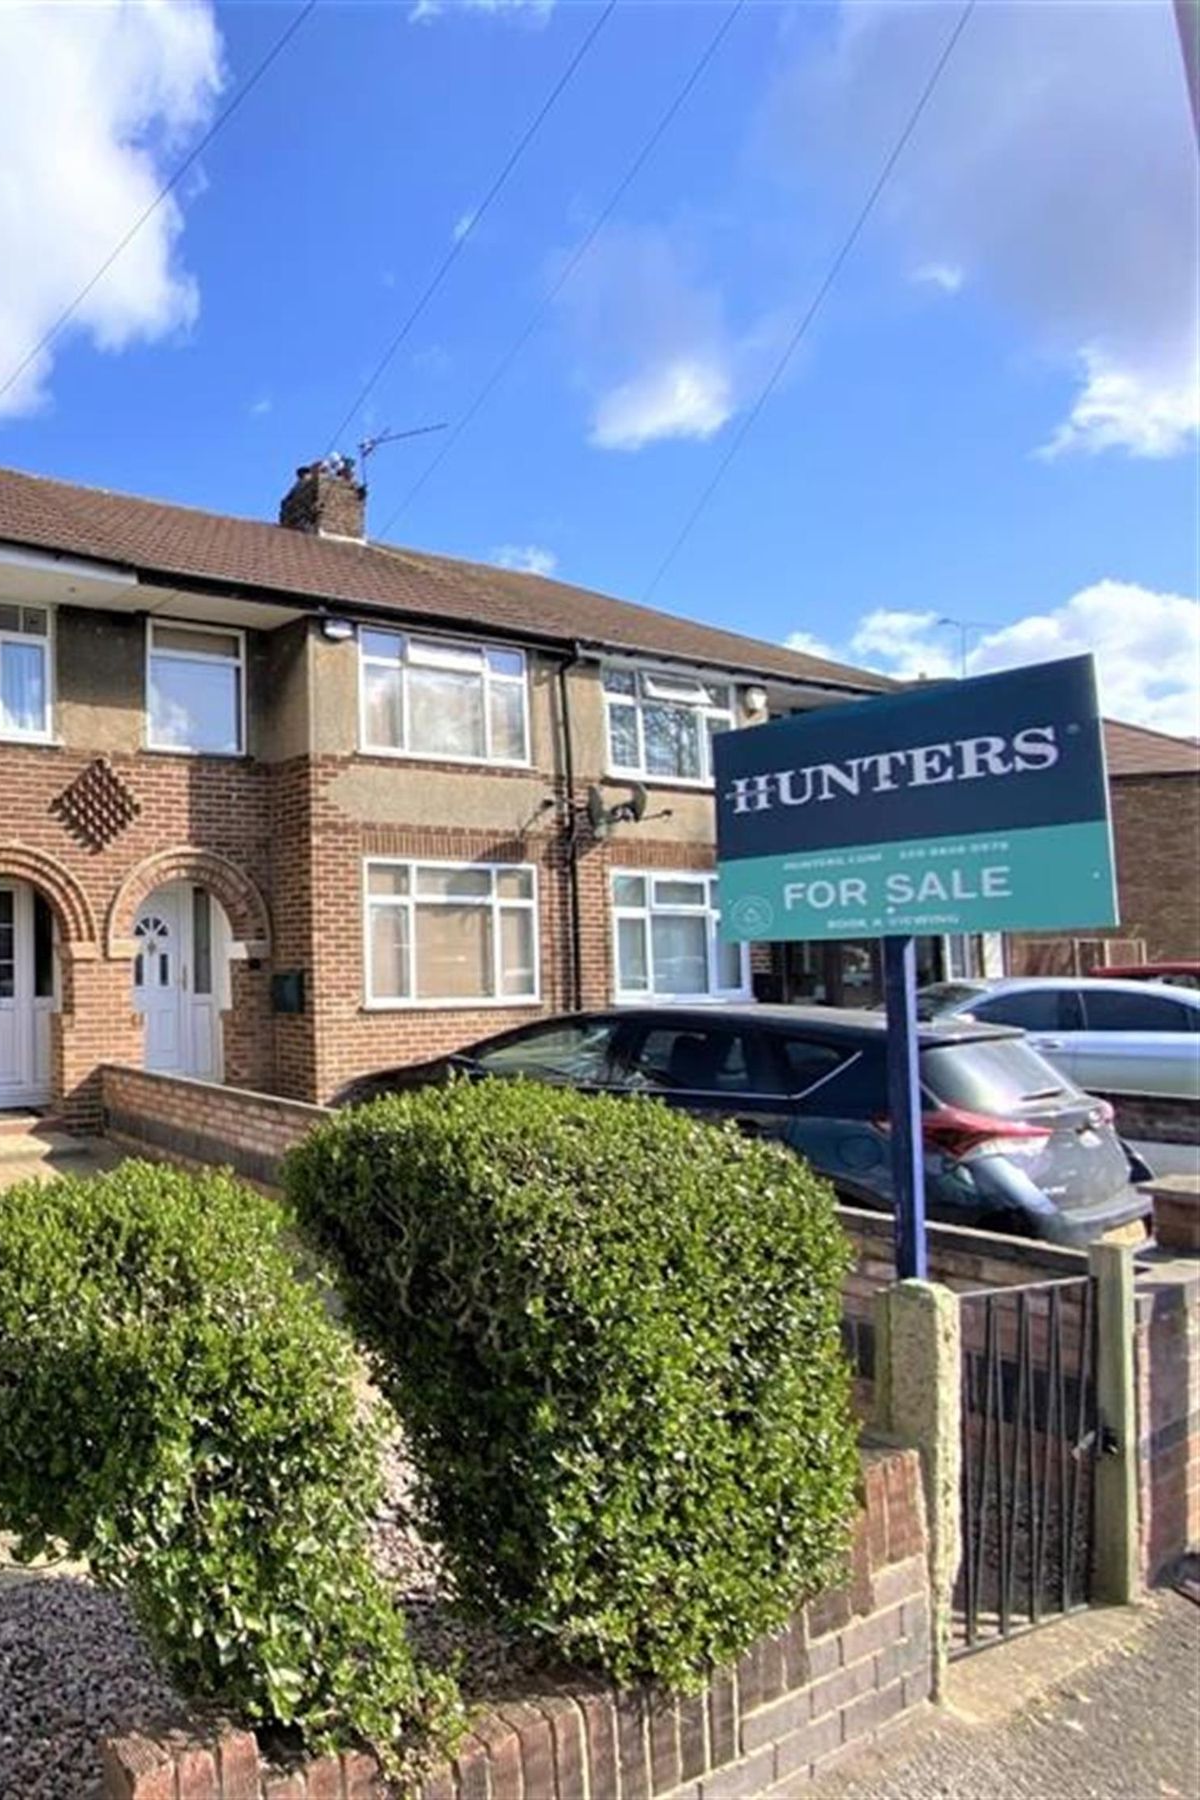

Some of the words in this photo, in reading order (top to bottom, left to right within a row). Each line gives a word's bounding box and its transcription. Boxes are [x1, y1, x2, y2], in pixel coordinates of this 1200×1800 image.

[726, 724, 1060, 814] HUNTERS
[783, 877, 867, 911] FOR
[885, 865, 1013, 904] SALE
